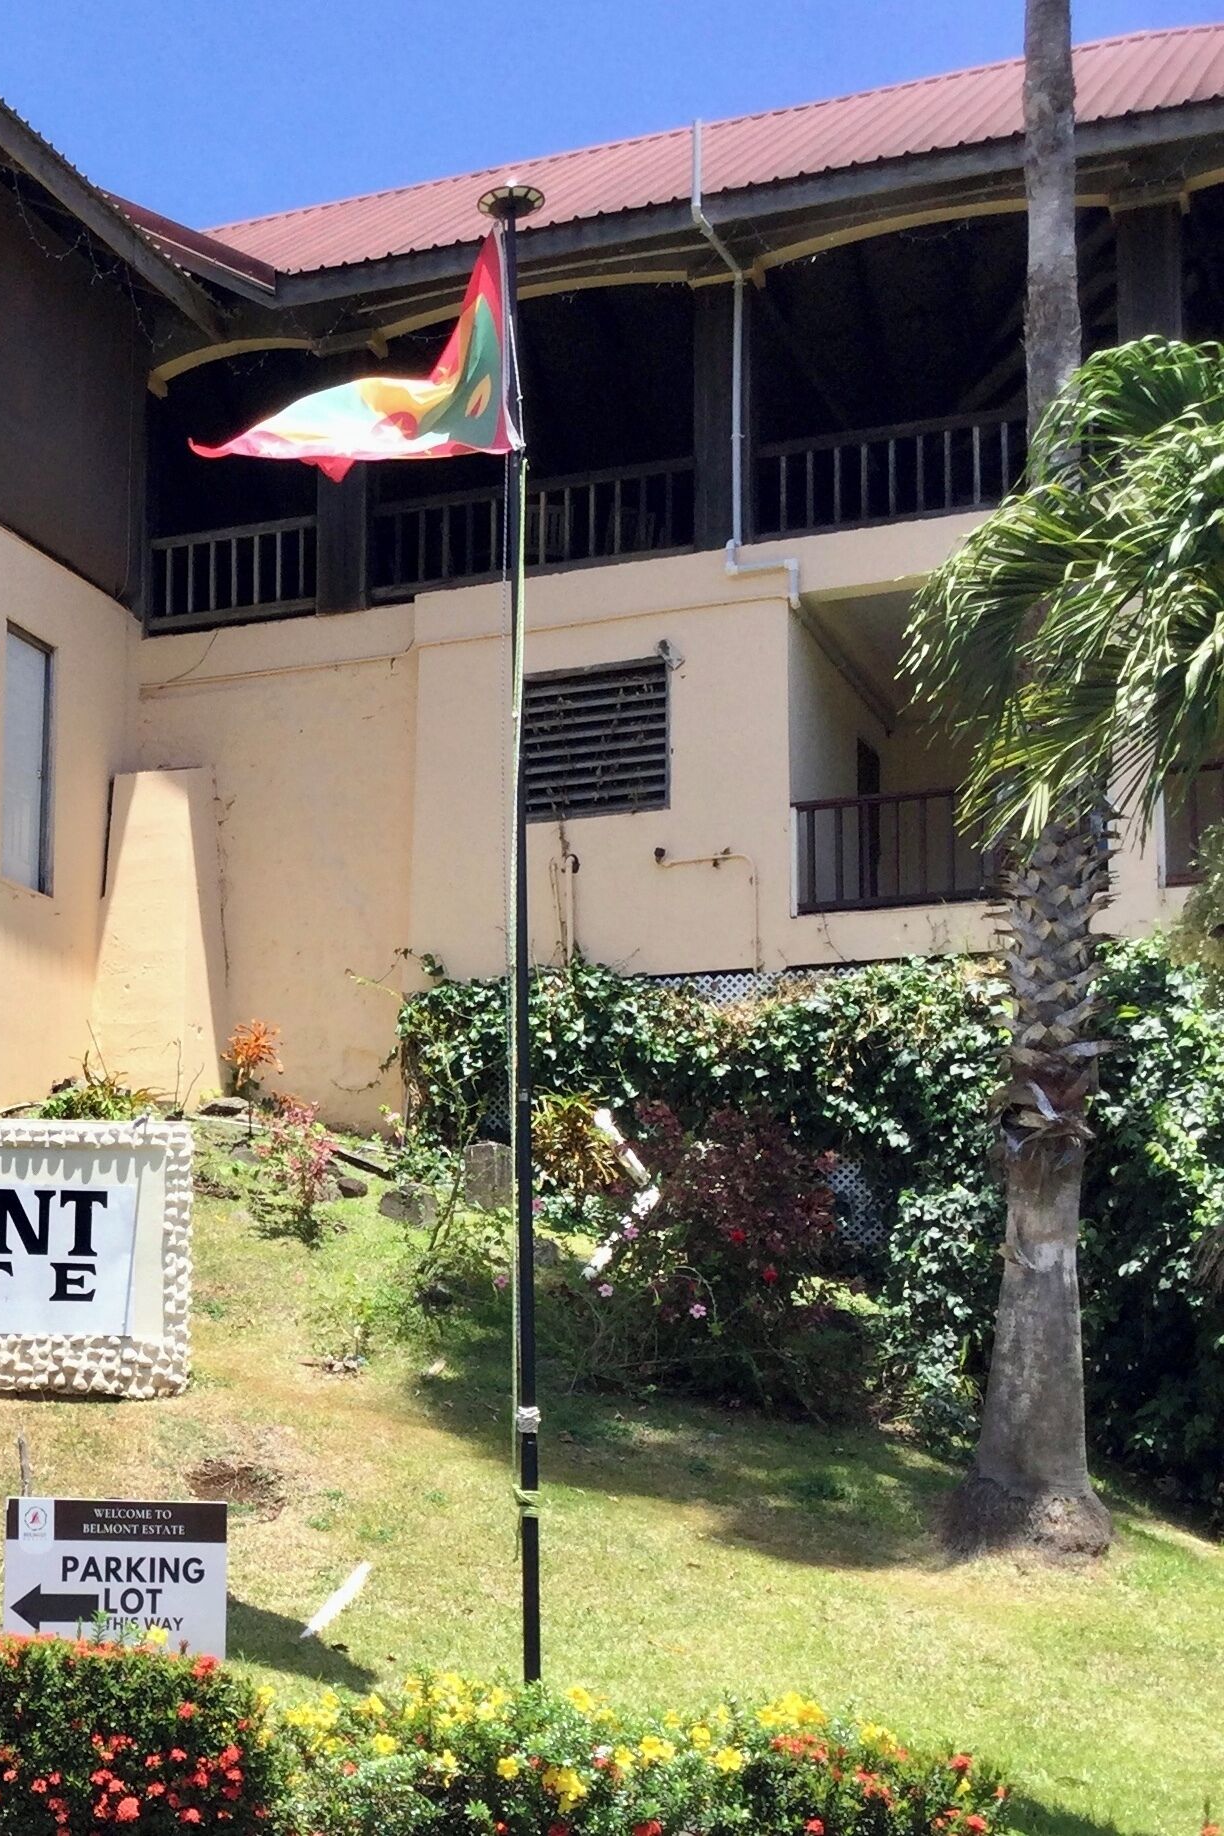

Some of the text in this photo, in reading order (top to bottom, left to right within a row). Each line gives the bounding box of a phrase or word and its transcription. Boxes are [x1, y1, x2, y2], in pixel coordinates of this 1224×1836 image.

[93, 1508, 172, 1519] WELCOME TO
[82, 1523, 185, 1535] BELMONT ESTATE
[61, 1556, 205, 1584] PARKING
[104, 1588, 163, 1614] LOT
[144, 1617, 184, 1631] WAY
